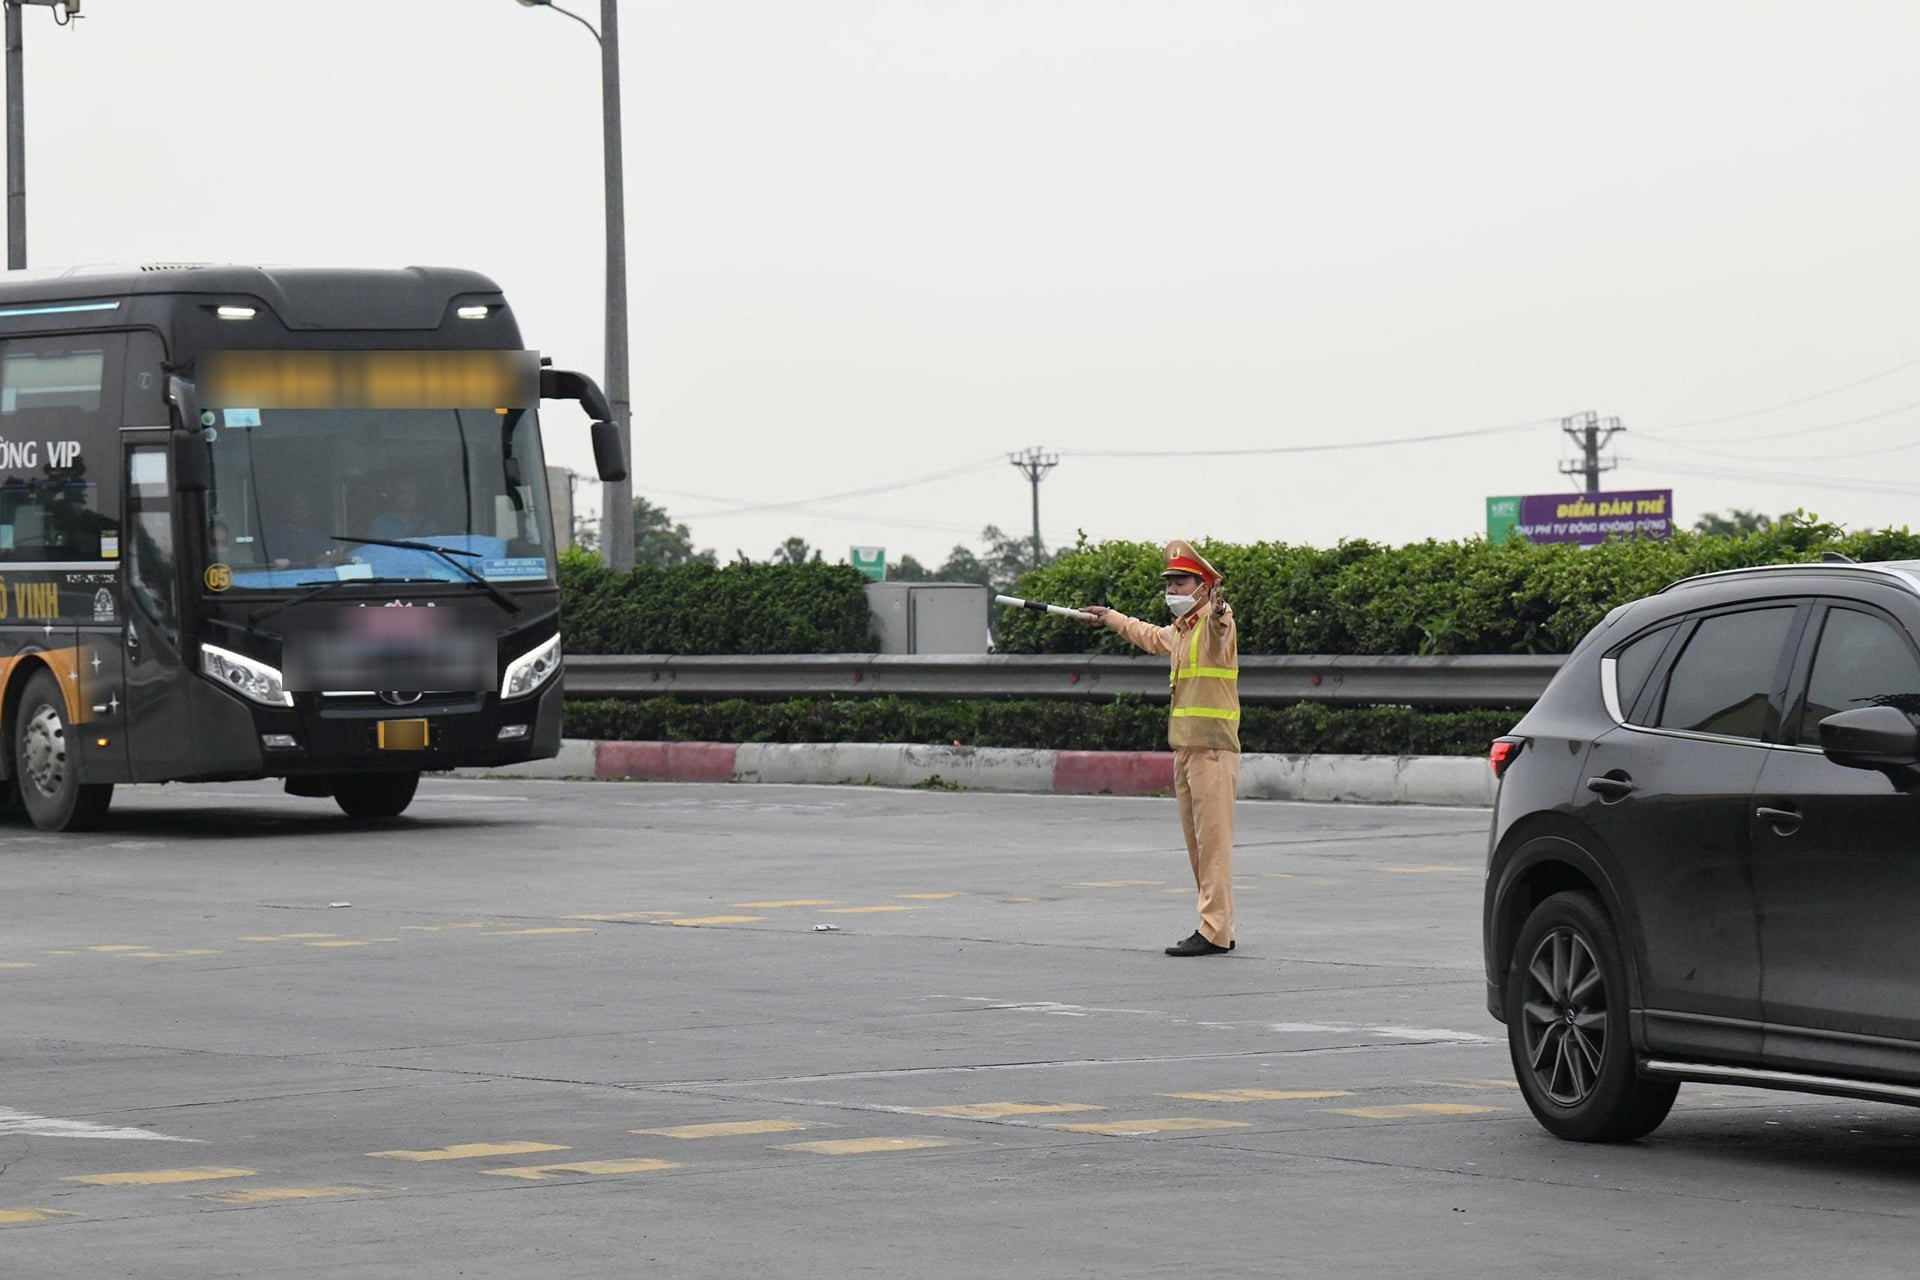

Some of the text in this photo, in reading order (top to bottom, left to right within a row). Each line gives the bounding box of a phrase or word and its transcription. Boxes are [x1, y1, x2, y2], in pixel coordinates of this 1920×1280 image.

[46, 440, 81, 468] VIP
[1557, 496, 1596, 518] ĐIỂM
[1598, 498, 1634, 517] DÁN
[209, 568, 229, 587] 05
[13, 582, 59, 619] VINH
